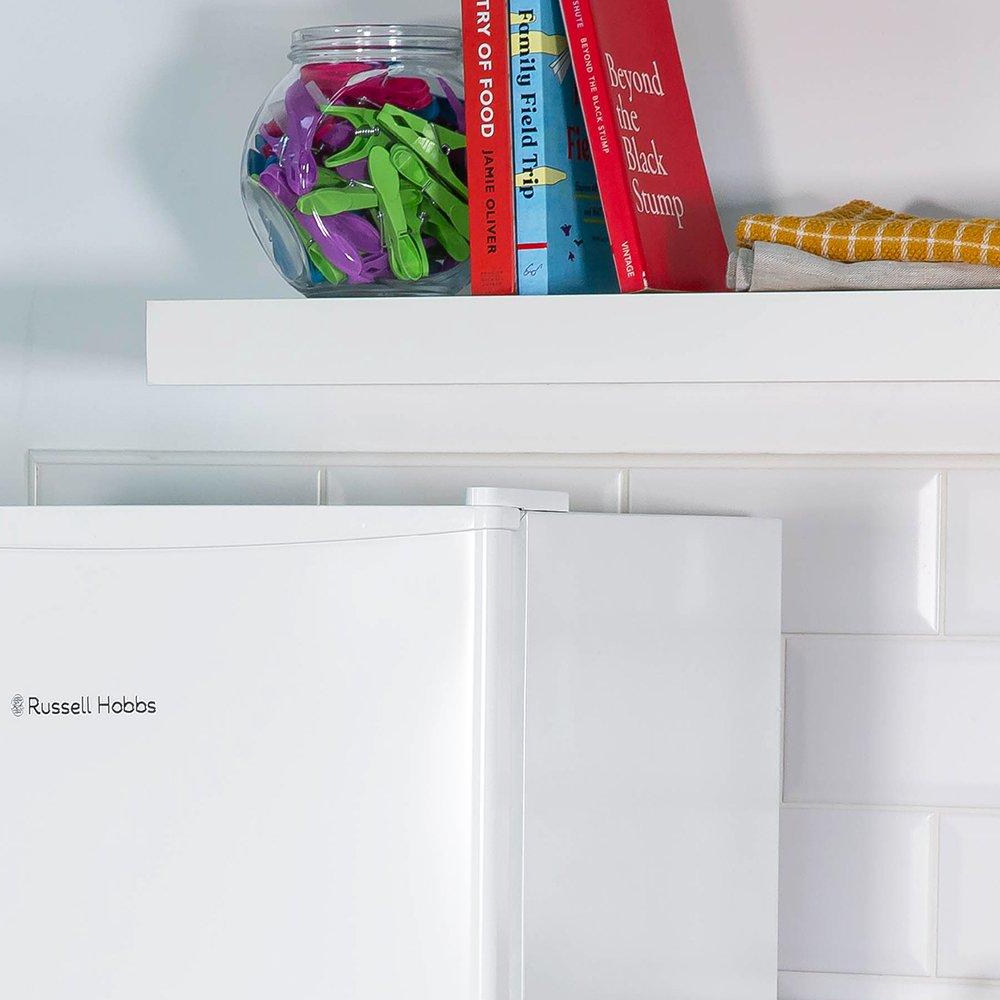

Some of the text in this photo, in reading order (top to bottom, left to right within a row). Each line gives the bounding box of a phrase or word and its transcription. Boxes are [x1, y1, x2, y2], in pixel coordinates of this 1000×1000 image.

[477, 42, 492, 71] OF
[572, 0, 610, 154] SHUTE BEYOND THE BLACK STUMP
[604, 52, 665, 102] Beyond
[479, 77, 495, 138] FOOD
[516, 9, 540, 199] Family Field Trip
[616, 94, 640, 132] the
[622, 136, 668, 176] Black
[481, 149, 497, 255] JAMIE OLIVER
[632, 178, 684, 229] Stump
[621, 241, 635, 278] VINTAGE
[28, 695, 157, 715] Russell Hobbs
